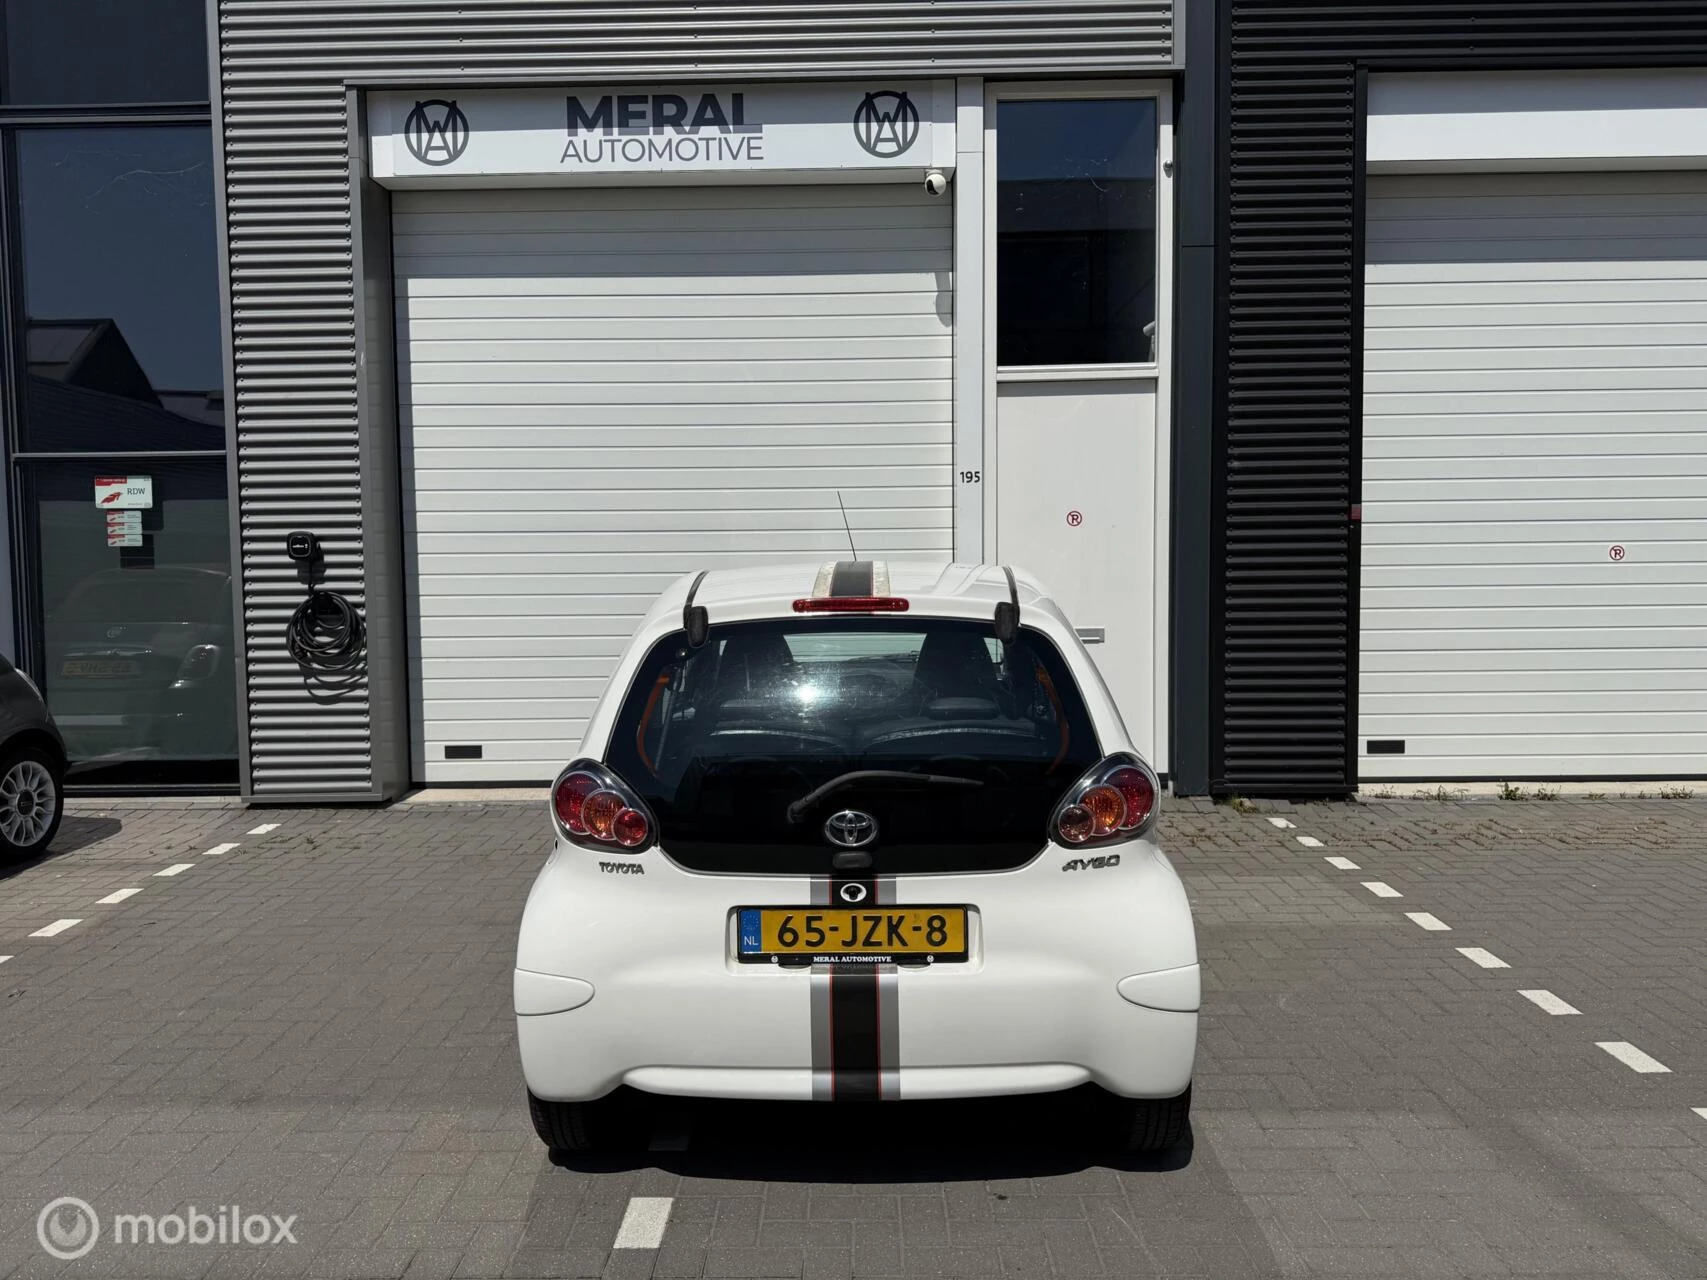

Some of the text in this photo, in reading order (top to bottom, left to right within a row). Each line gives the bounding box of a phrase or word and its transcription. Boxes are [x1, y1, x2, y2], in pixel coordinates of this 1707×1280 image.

[566, 92, 764, 137] MERAL
[560, 135, 764, 164] AUTOMOTIVE
[959, 471, 981, 484] 195
[126, 487, 146, 496] RDW
[598, 861, 645, 875] TOYOTA
[1061, 854, 1121, 872] AYGO
[777, 915, 947, 947] 65-JZK-8
[743, 936, 759, 946] NL
